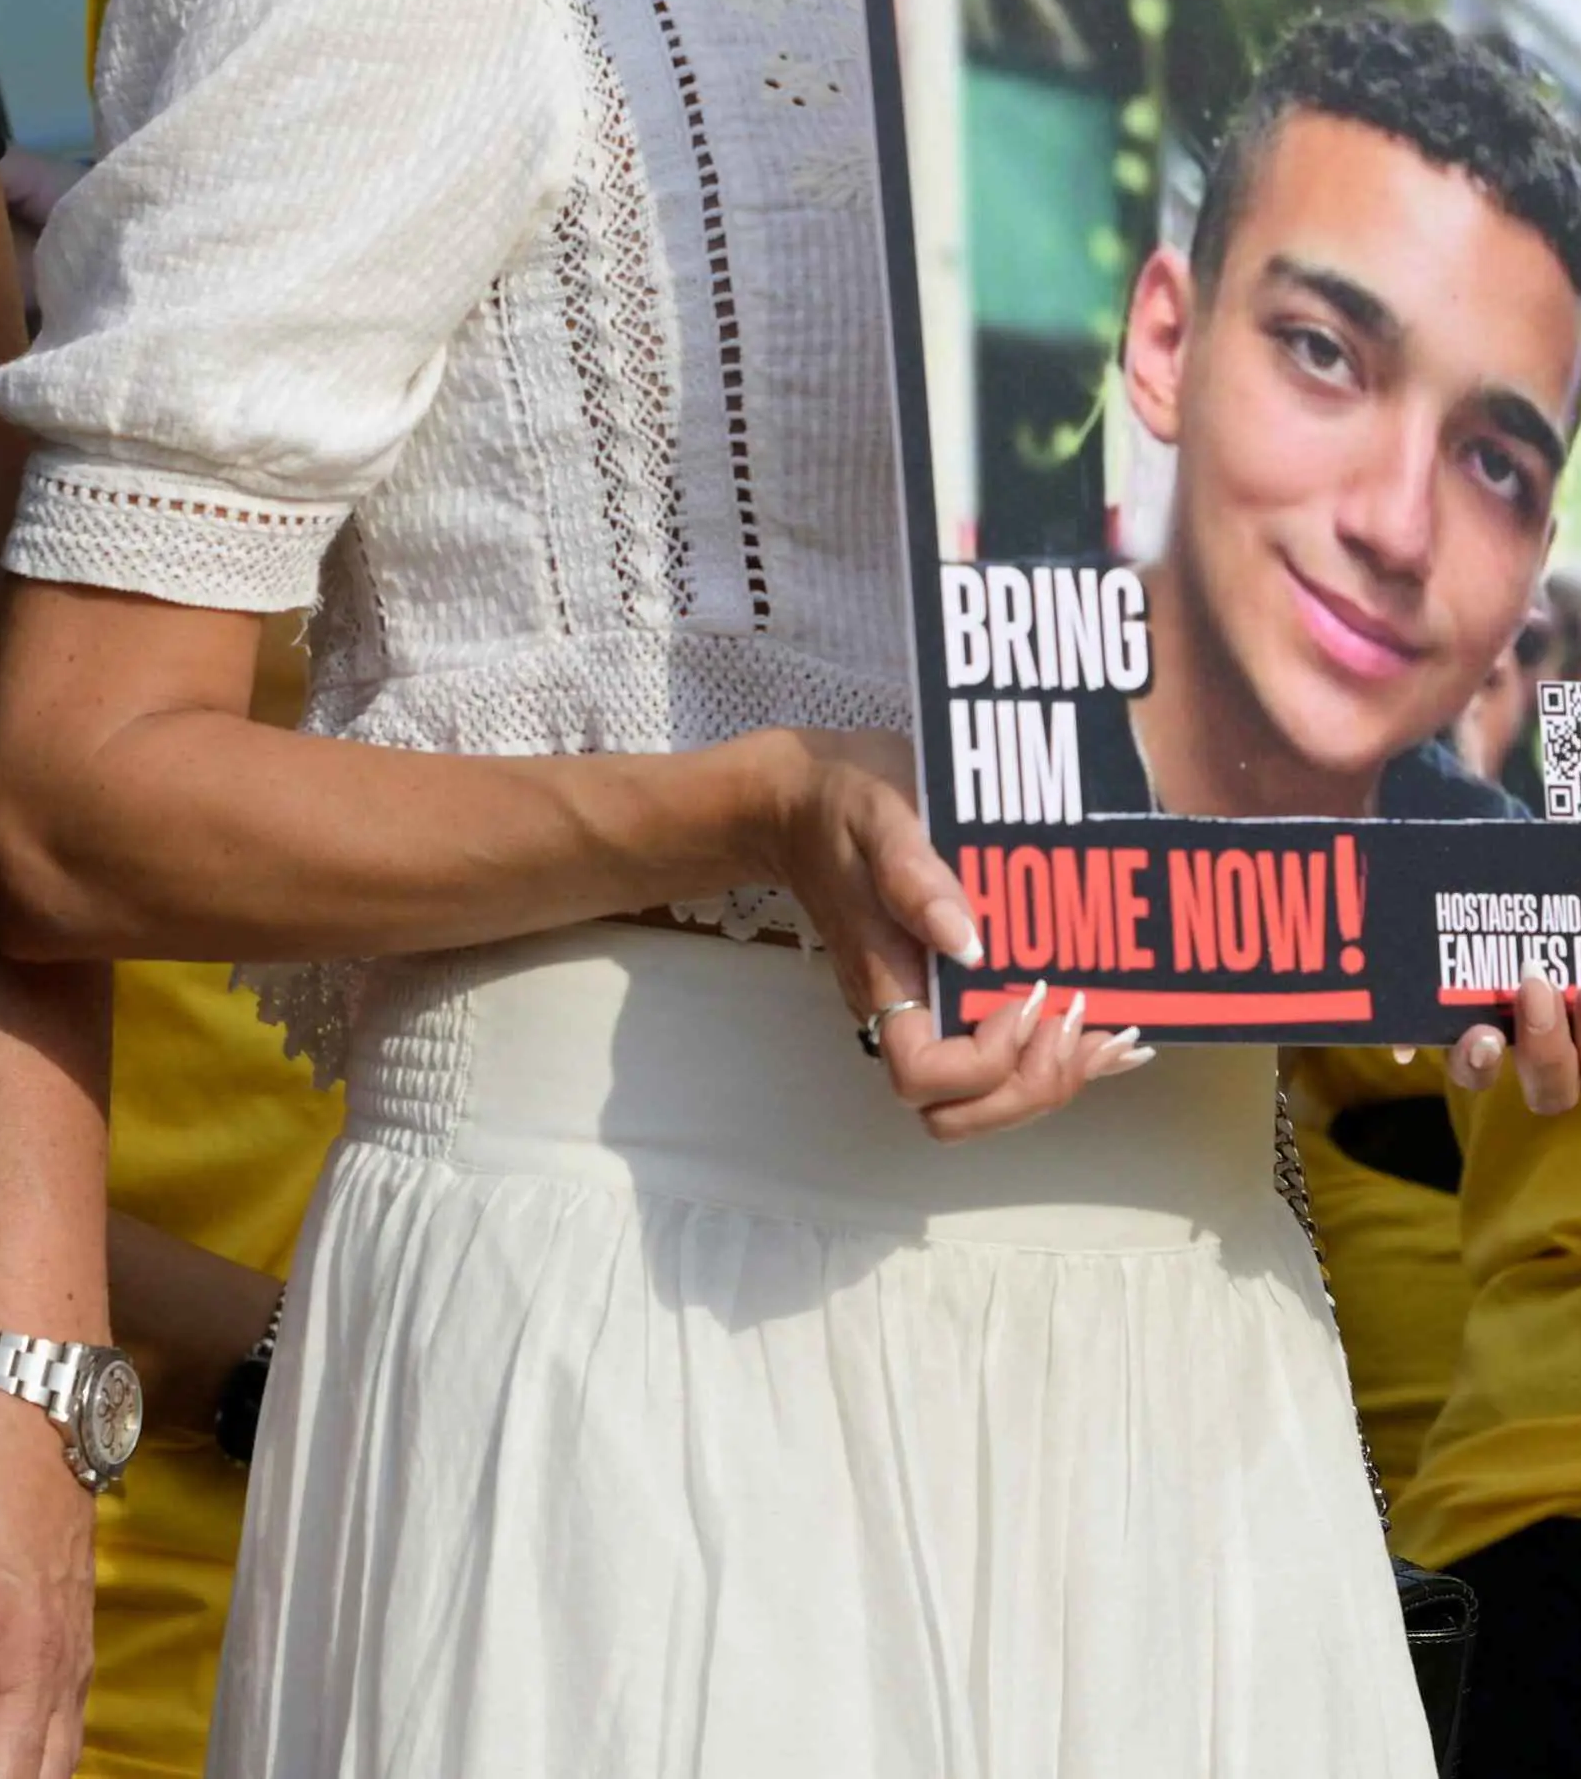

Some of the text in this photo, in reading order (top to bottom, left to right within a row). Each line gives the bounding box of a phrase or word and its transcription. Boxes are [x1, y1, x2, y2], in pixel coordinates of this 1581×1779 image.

[941, 564, 1149, 692] BRING
[949, 697, 1083, 824] HIM
[959, 834, 1367, 975] HOME NOW!
[1435, 892, 1538, 933] HOSTAGES
[1541, 894, 1581, 933] AND
